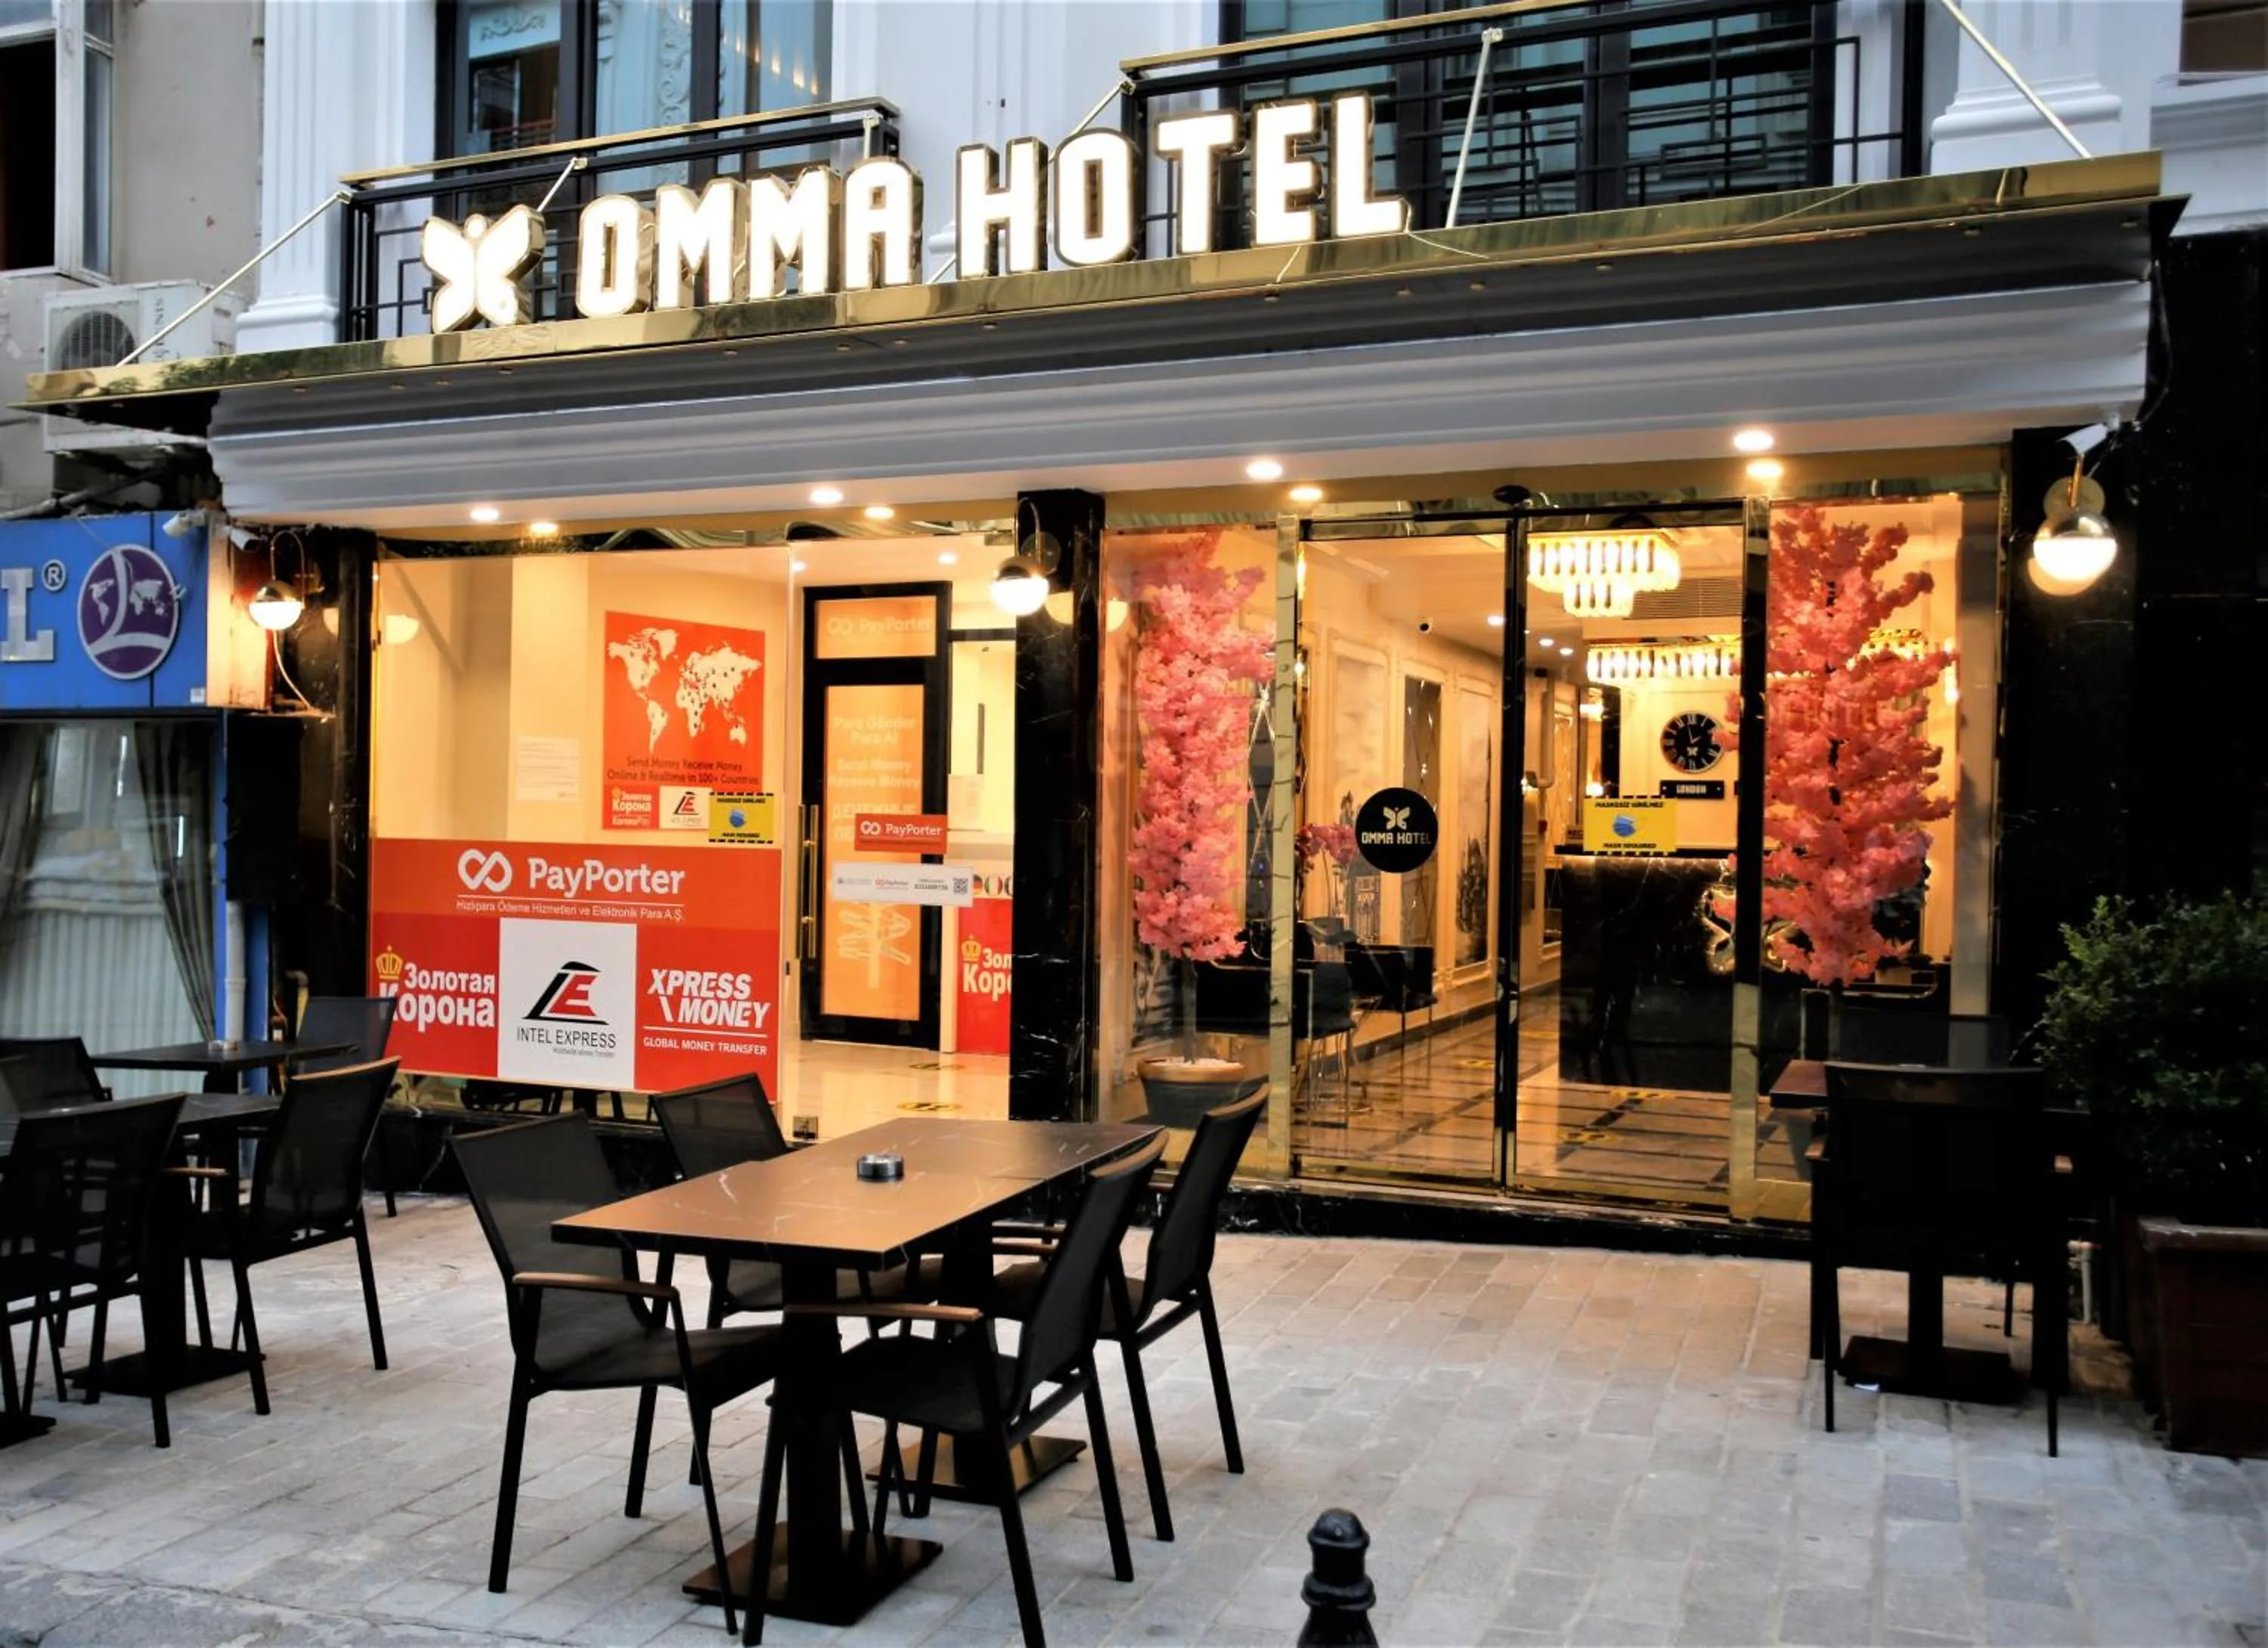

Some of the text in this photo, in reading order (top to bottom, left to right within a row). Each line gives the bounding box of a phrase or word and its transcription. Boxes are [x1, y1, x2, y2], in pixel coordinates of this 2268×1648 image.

[576, 91, 1408, 318] OMMA HOTEL
[885, 823, 943, 837] PayPorter
[1362, 832, 1433, 844] OMMA HOTEL
[528, 857, 685, 898] PayPorter
[982, 947, 1012, 968] Зол
[404, 962, 495, 994] Золотая
[647, 968, 754, 1000] XPRESS
[677, 997, 771, 1029] MONEY
[516, 1027, 616, 1049] INTEL EXPRESS
[643, 1036, 767, 1056] GLOBAL MONEY TRANSFER
